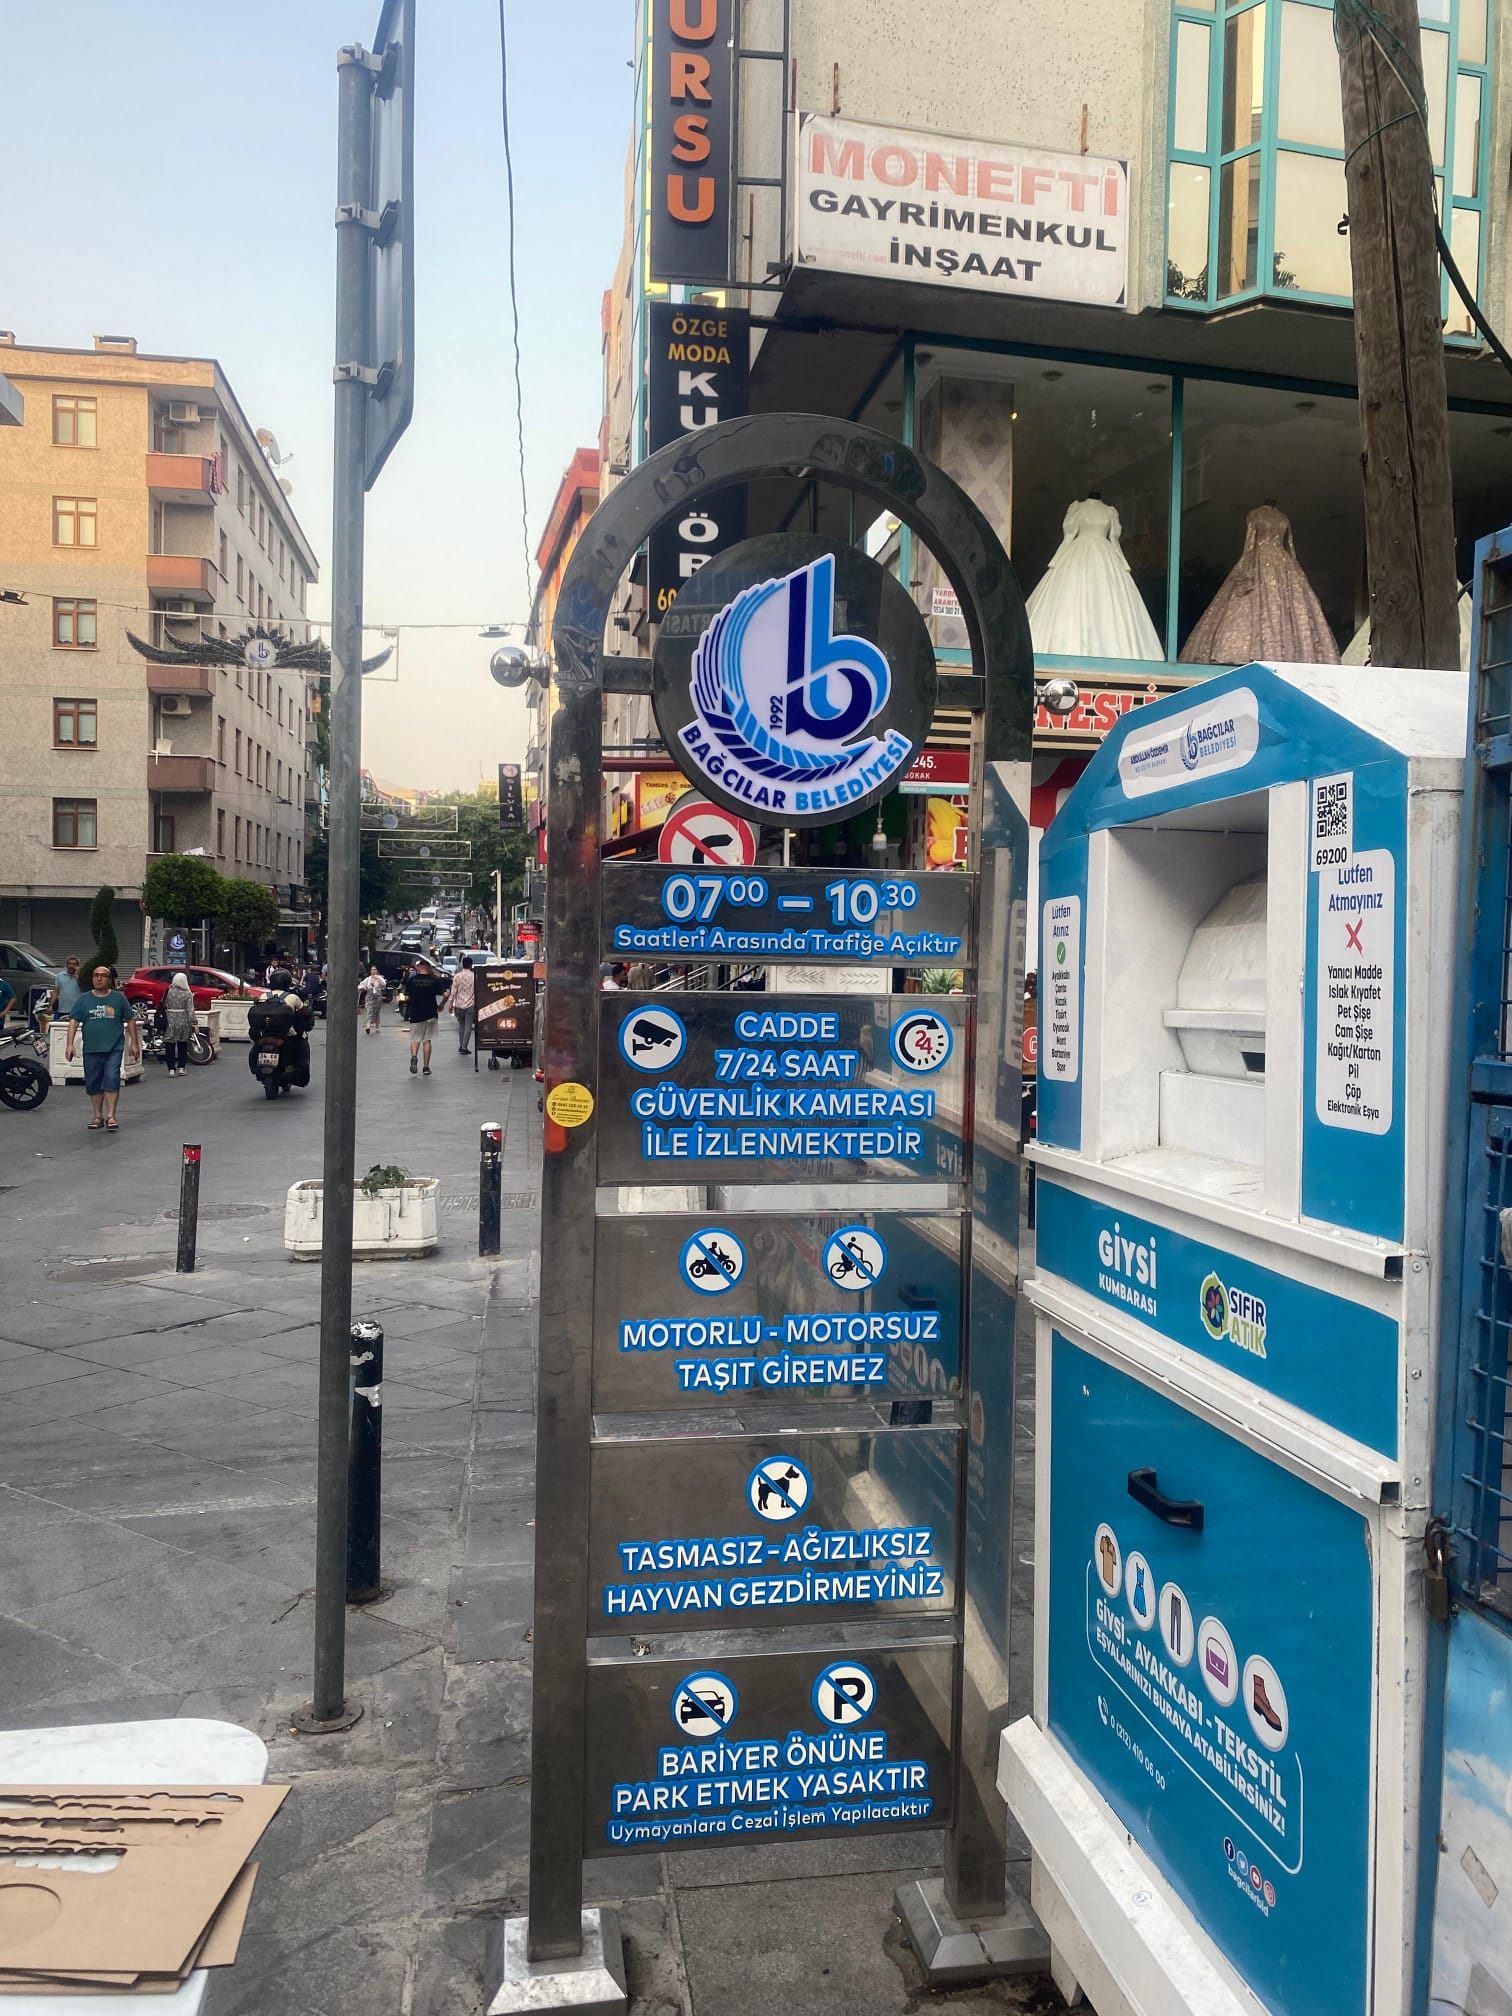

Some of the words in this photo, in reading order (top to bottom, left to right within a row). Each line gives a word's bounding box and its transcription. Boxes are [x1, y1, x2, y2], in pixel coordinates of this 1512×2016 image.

[810, 132, 1118, 217] MONEFTİ
[809, 189, 1117, 252] GAYRİMENKUL
[889, 236, 1042, 282] İNŞAAT
[672, 312, 728, 338] ÖZGE
[668, 342, 731, 365] MODA
[769, 695, 783, 731] 1992
[1197, 718, 1235, 744] BAĞCILAR
[683, 725, 786, 810] BAĞCILAR
[795, 730, 910, 811] BELEDİYESİ
[1316, 846, 1348, 866] 69200
[1051, 905, 1071, 920] Lütfen
[1328, 893, 1383, 914] Atmayınız
[617, 928, 707, 950] Saatleri
[710, 931, 807, 951] Arasında
[810, 931, 885, 956] Trafiğe
[889, 935, 959, 958] Açıktır
[1053, 924, 1070, 938] Atınız
[1327, 965, 1353, 981] Yanıcı
[1354, 965, 1383, 980] Madde
[1328, 984, 1349, 999] Islak
[1350, 985, 1381, 1002] Kıyafet
[739, 1016, 837, 1038] CADDE
[1337, 1004, 1352, 1019] Pet
[1353, 1004, 1372, 1022] Şişe
[1335, 1023, 1354, 1038] Cam
[1355, 1024, 1373, 1043] Şişe
[718, 1053, 777, 1081] 7/24
[783, 1053, 856, 1078] SAAT
[1327, 1042, 1381, 1062] Kağıt/Karton
[1348, 1063, 1359, 1079] Pil
[635, 1086, 787, 1118] GÜVENLİK
[789, 1092, 933, 1118] KAMERASI
[1345, 1083, 1362, 1101] Çöp
[1327, 1099, 1362, 1116] Elektronik
[1362, 1105, 1380, 1121] Eşya
[646, 1125, 689, 1157] İLE
[697, 1125, 921, 1157] İZLENMEKTEDİR
[1098, 1222, 1157, 1290] GİYSİ
[1098, 1272, 1157, 1318] KUMBARASI
[1229, 1290, 1265, 1328] SIFIR
[623, 1320, 762, 1348] MOTORLU
[787, 1315, 939, 1344] MOTORSUZ
[1229, 1316, 1266, 1356] ATIK
[679, 1361, 755, 1391] TAŞIT
[762, 1354, 885, 1384] GİREMEZ
[607, 1583, 722, 1613] HAYVAN
[729, 1562, 941, 1606] GEZDİRMEYİNİZ
[1096, 1598, 1125, 1646] GİYSİ
[1135, 1640, 1203, 1726] AYAKKABI
[1214, 1715, 1287, 1808] TEKSTİL
[1096, 1626, 1152, 1700] EŞYALARINIZI
[1152, 1688, 1193, 1744] BURAYA
[1193, 1732, 1286, 1837] ATABİLİRSİNİZ!
[662, 1743, 778, 1777] BARİYER
[786, 1733, 884, 1767] ÖNÜNE
[1110, 1714, 1116, 1729] 0
[1116, 1722, 1132, 1751] (212)
[1132, 1742, 1144, 1764] 410
[1144, 1757, 1154, 1777] 06
[1155, 1769, 1166, 1791] 00
[616, 1784, 689, 1813] PARK
[697, 1776, 790, 1806] ETMEK
[796, 1765, 927, 1797] YASAKTIR
[611, 1817, 727, 1842] Uymayanlara
[731, 1810, 779, 1831] Cezai
[782, 1805, 826, 1829] İşlem
[831, 1801, 930, 1822] Yapılacaktır
